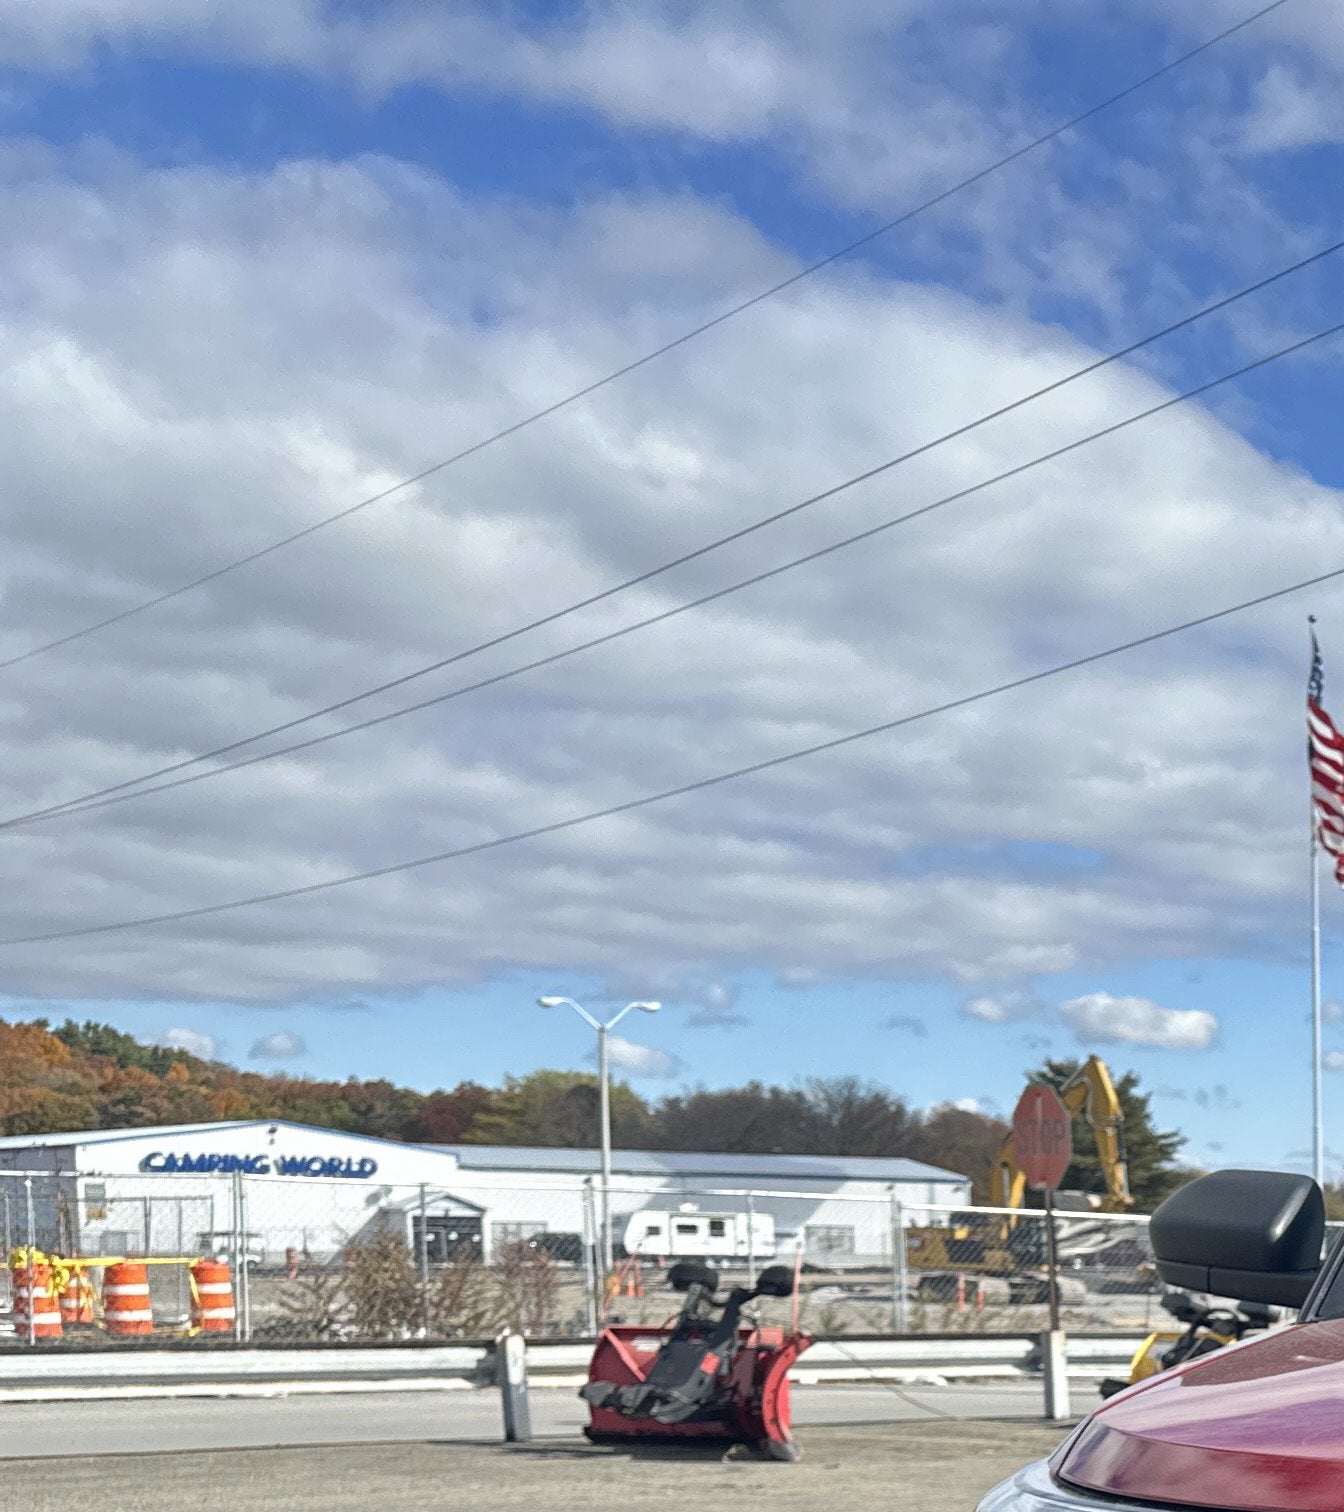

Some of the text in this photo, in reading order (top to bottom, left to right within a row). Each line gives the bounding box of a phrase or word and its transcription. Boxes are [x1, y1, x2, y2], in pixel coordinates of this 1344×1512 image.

[1016, 1118, 1066, 1156] STOP
[138, 1151, 378, 1179] CAMPING WORLD
